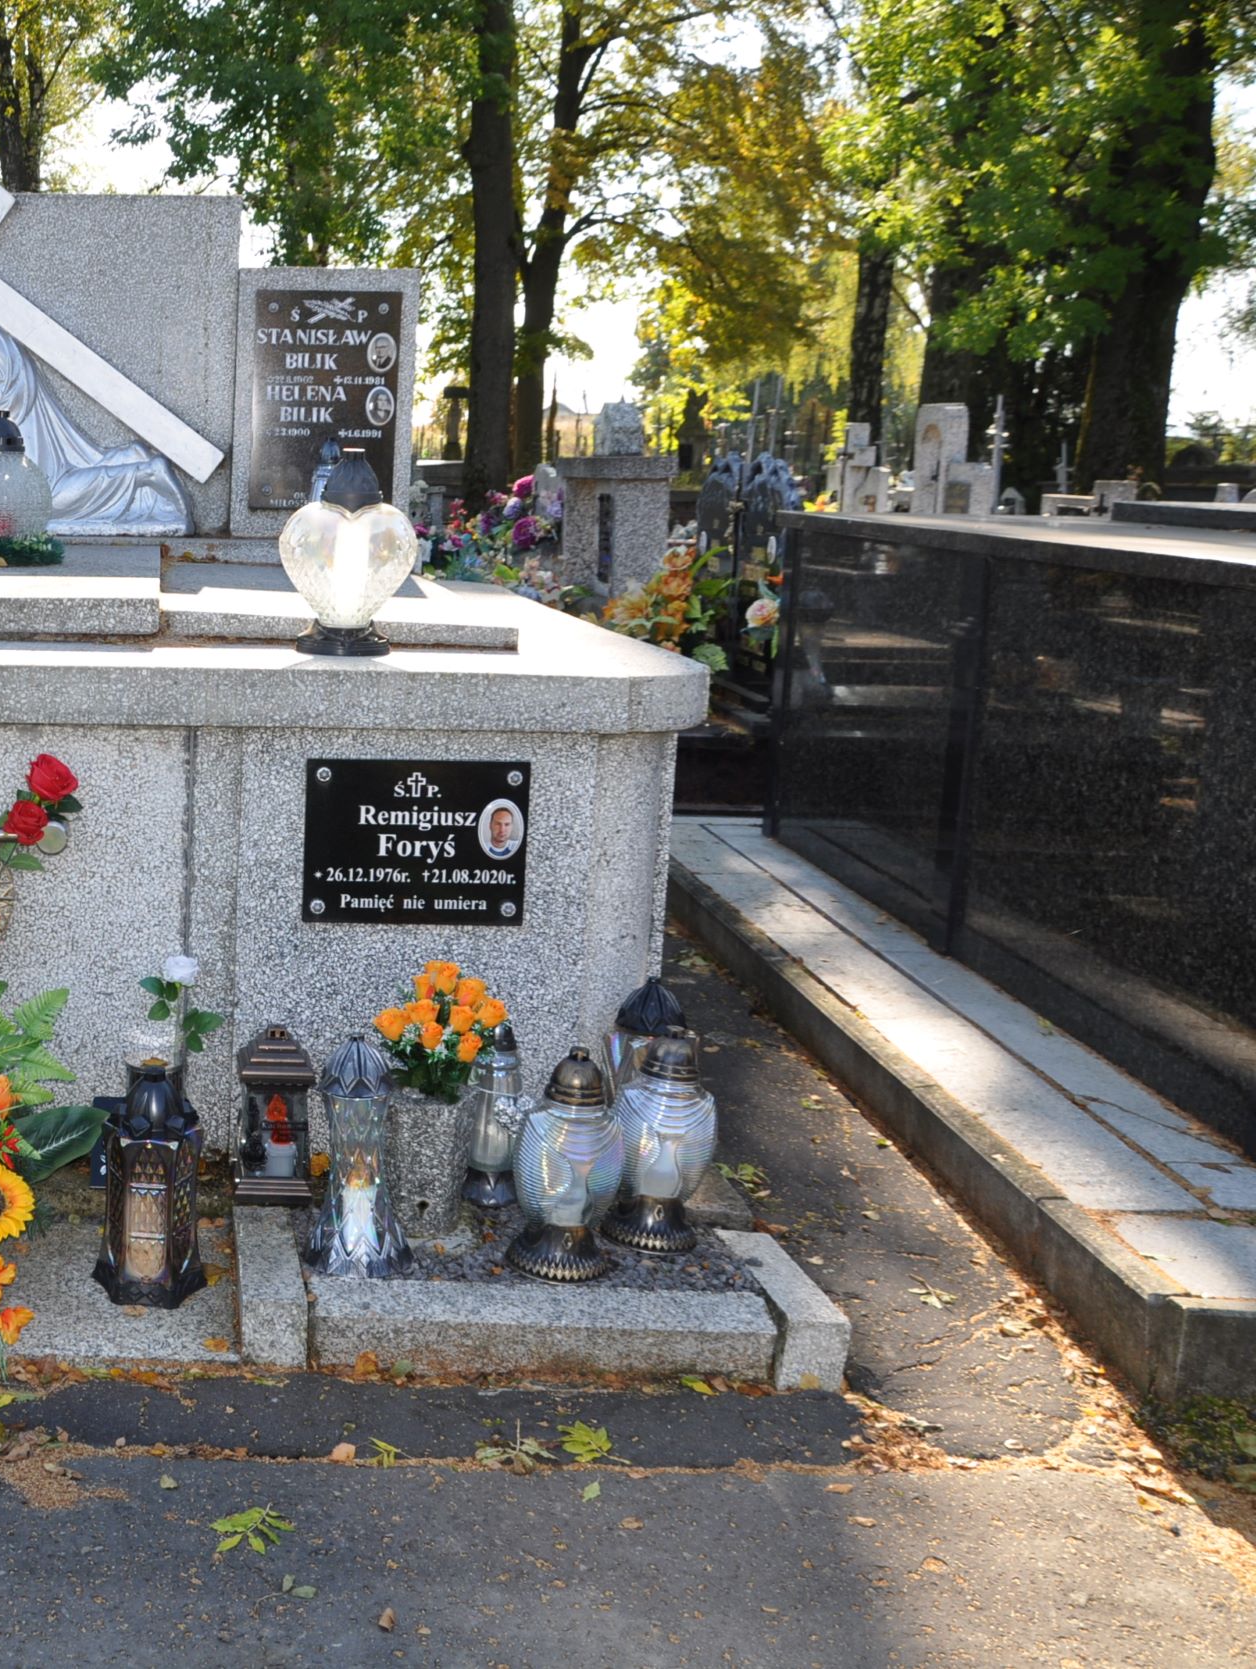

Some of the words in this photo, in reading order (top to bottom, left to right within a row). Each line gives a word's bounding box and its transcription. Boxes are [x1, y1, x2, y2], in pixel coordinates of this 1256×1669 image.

[357, 310, 368, 323] P
[257, 328, 372, 345] STANISŁAW
[285, 353, 338, 370] BILIK
[266, 385, 347, 402] HELENA
[280, 407, 333, 424] BILIK
[358, 805, 477, 830] Remigiusz
[376, 834, 456, 864] Foryś
[326, 867, 411, 884] 26.12.1976r.
[432, 869, 516, 885] 21.08.2020r.
[339, 894, 394, 912] Pamięć
[403, 896, 426, 910] nie
[434, 898, 487, 911] umiera
